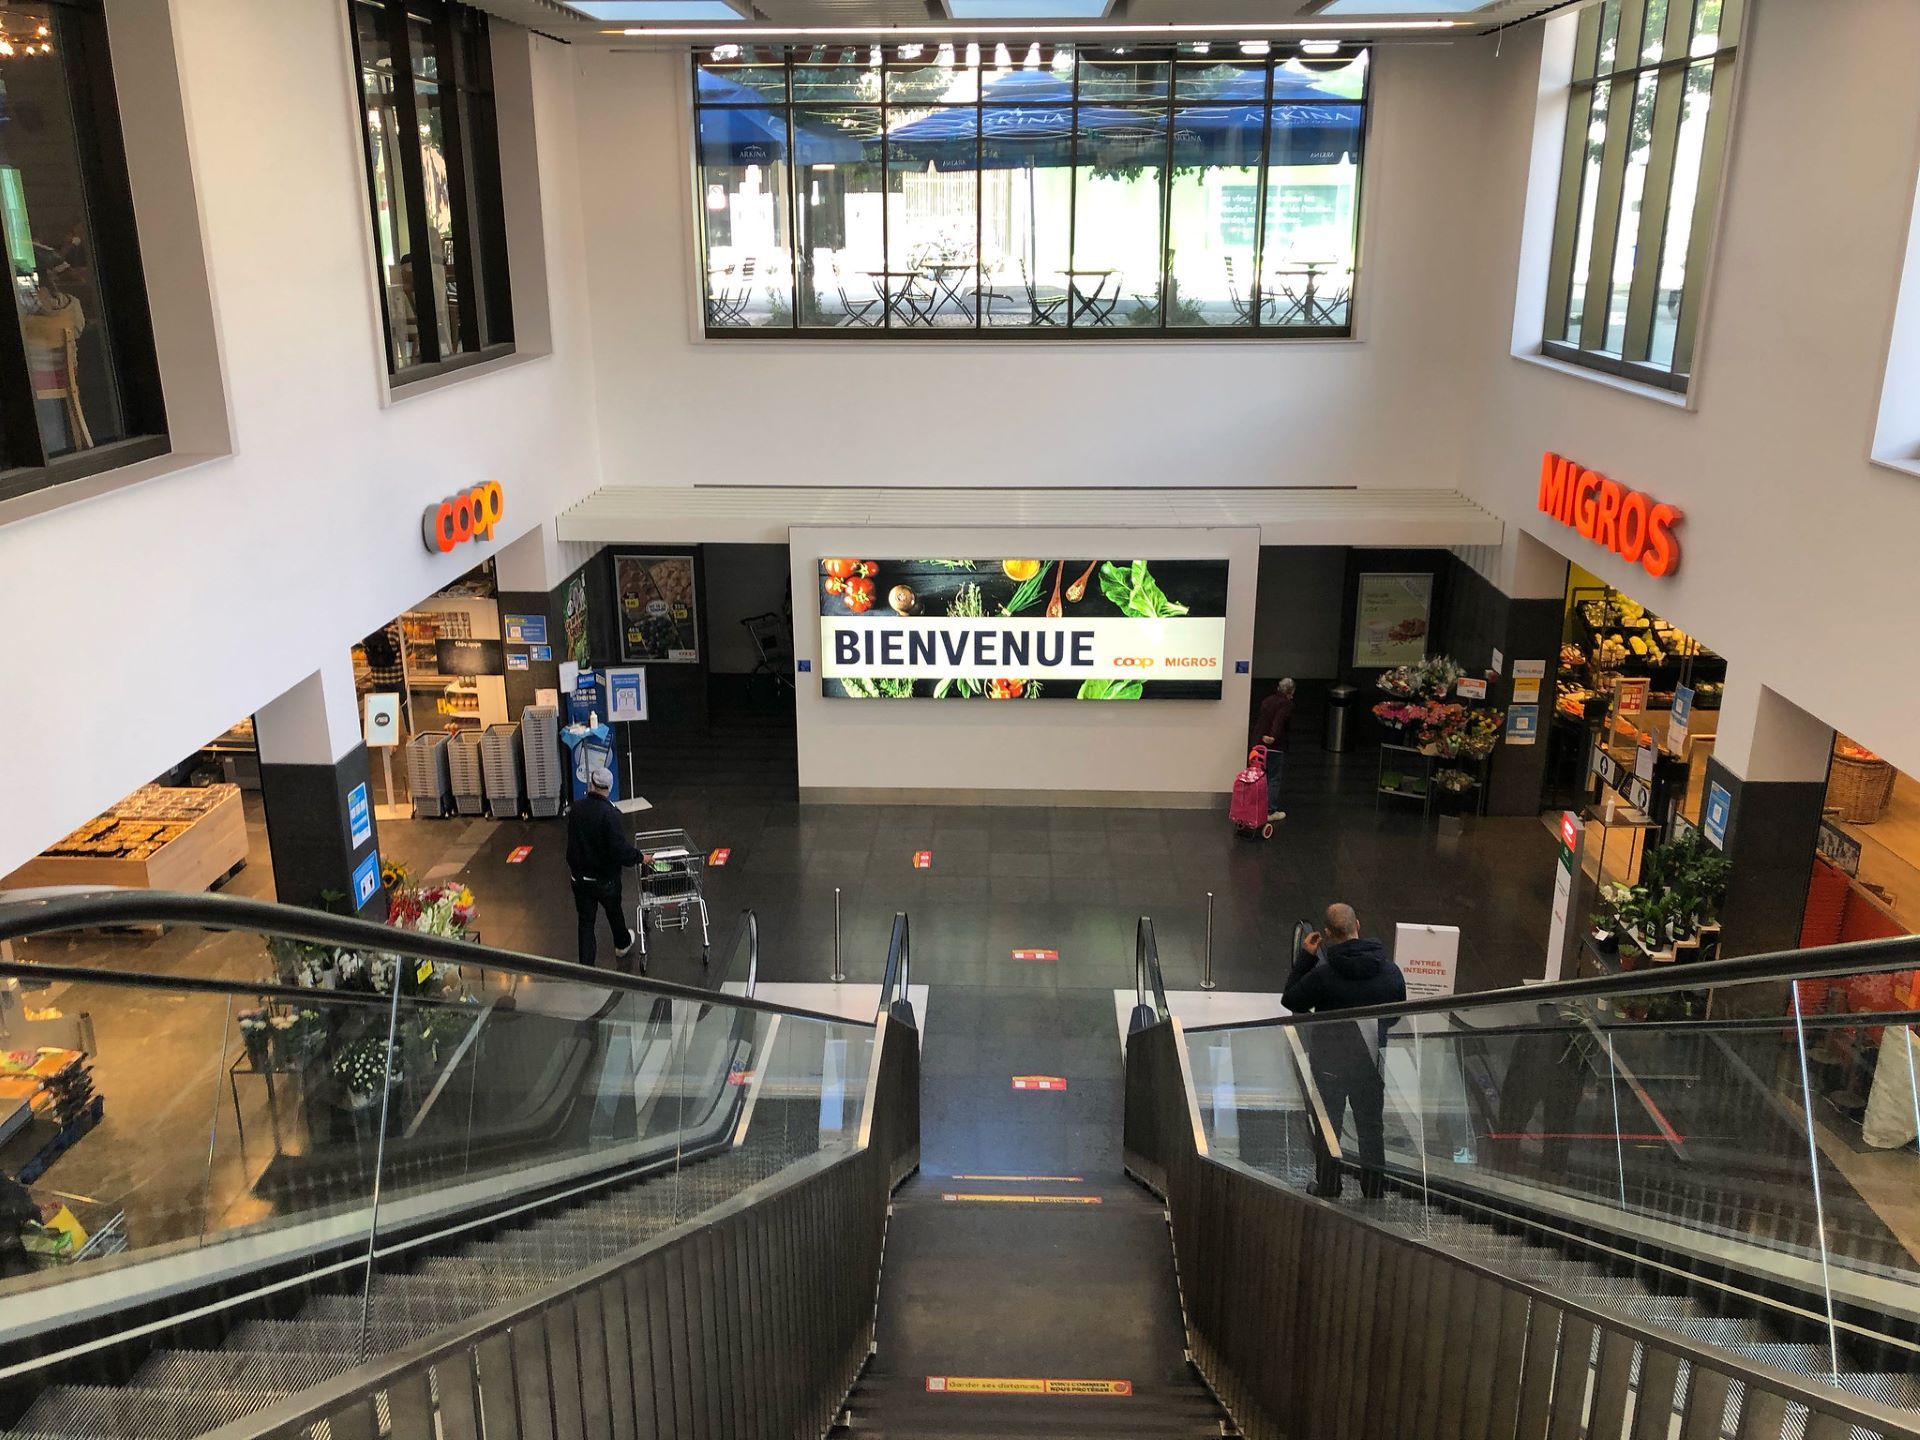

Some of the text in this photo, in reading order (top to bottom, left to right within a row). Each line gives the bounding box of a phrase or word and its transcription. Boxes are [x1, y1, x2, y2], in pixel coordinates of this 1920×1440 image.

[1174, 133, 1202, 142] ARKINA
[739, 150, 767, 159] ARKINA
[430, 480, 503, 553] coop
[1538, 451, 1678, 577] MIGROS
[835, 629, 1095, 667] BIENVENUE
[1113, 656, 1217, 669] coop MIGROS
[1403, 967, 1447, 976] INTERDITE
